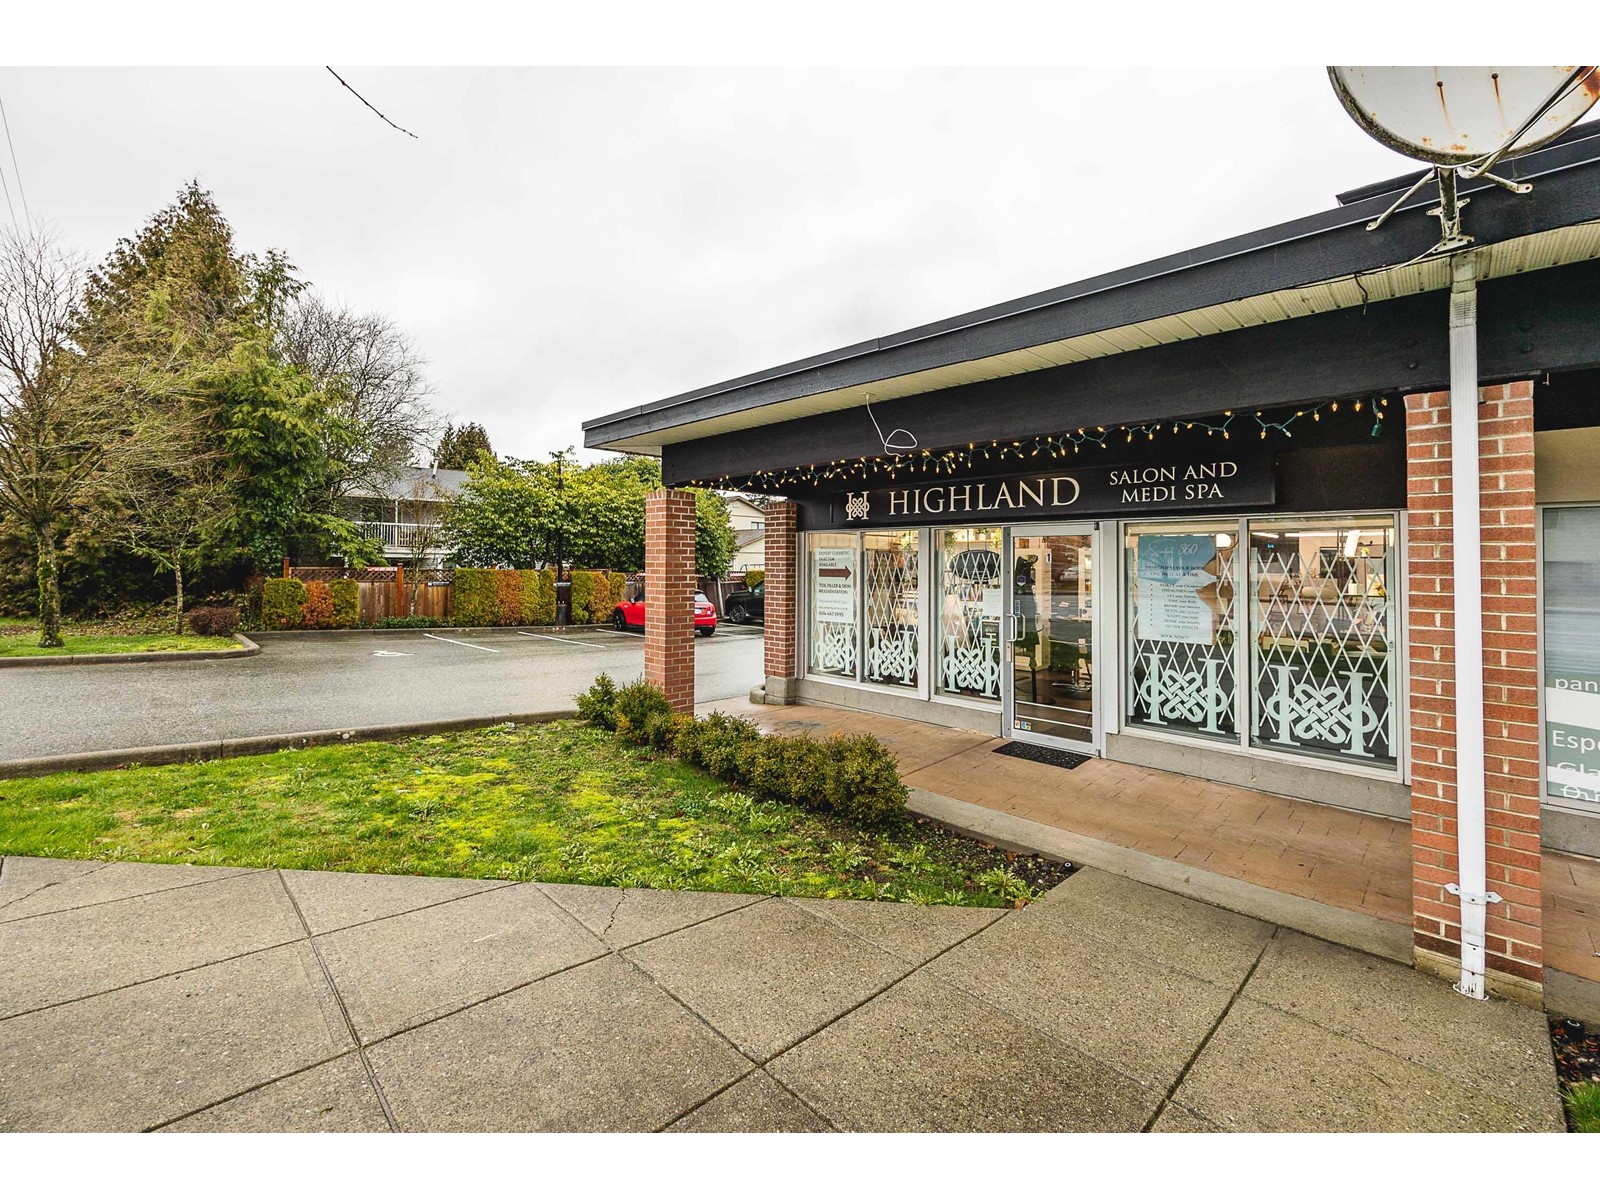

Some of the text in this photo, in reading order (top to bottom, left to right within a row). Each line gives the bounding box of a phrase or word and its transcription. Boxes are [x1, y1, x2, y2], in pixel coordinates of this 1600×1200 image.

[1109, 461, 1238, 486] SALON AND
[889, 477, 1080, 516] HIGHLAND
[1121, 483, 1224, 503] MEDI SPA
[1178, 543, 1199, 555] 360
[1555, 677, 1598, 692] pan
[1552, 729, 1600, 754] Esp
